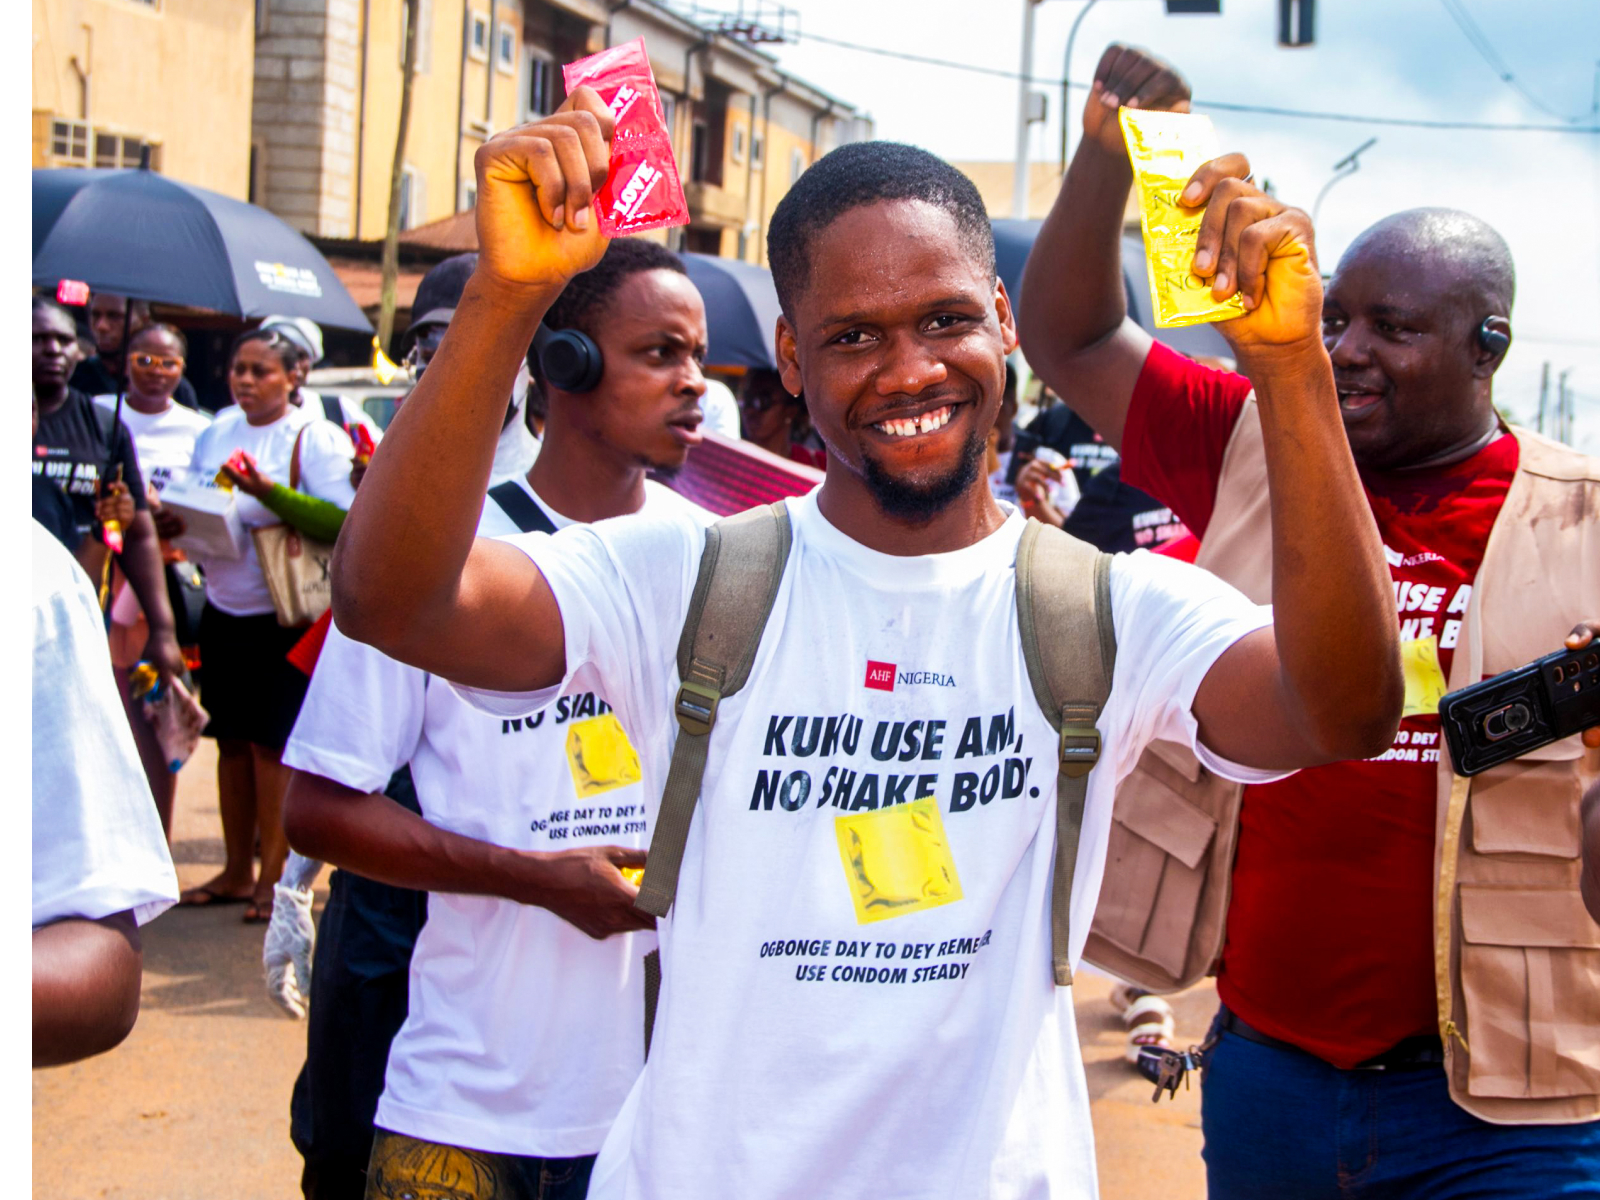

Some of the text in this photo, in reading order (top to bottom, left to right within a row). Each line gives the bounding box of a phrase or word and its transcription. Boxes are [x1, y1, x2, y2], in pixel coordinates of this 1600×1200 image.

[612, 159, 655, 216] LOVE
[1392, 581, 1472, 614] USE A
[1400, 616, 1463, 650] KE B
[869, 668, 956, 688] AHF NIGERIA
[762, 704, 1024, 763] KUKU USE AM,
[1411, 731, 1439, 746] DEY
[749, 769, 812, 813] NO
[815, 765, 939, 813] SHAKE
[573, 807, 596, 821] DAY
[599, 806, 613, 820] TO
[616, 804, 637, 819] DEY
[549, 826, 569, 840] USE
[572, 823, 622, 838] CONDOM
[760, 939, 832, 959] OGBONGE
[835, 940, 872, 958] DAY
[875, 941, 897, 960] TO
[900, 942, 936, 960] DEY
[795, 962, 970, 984] USE CONDOM STEADY
